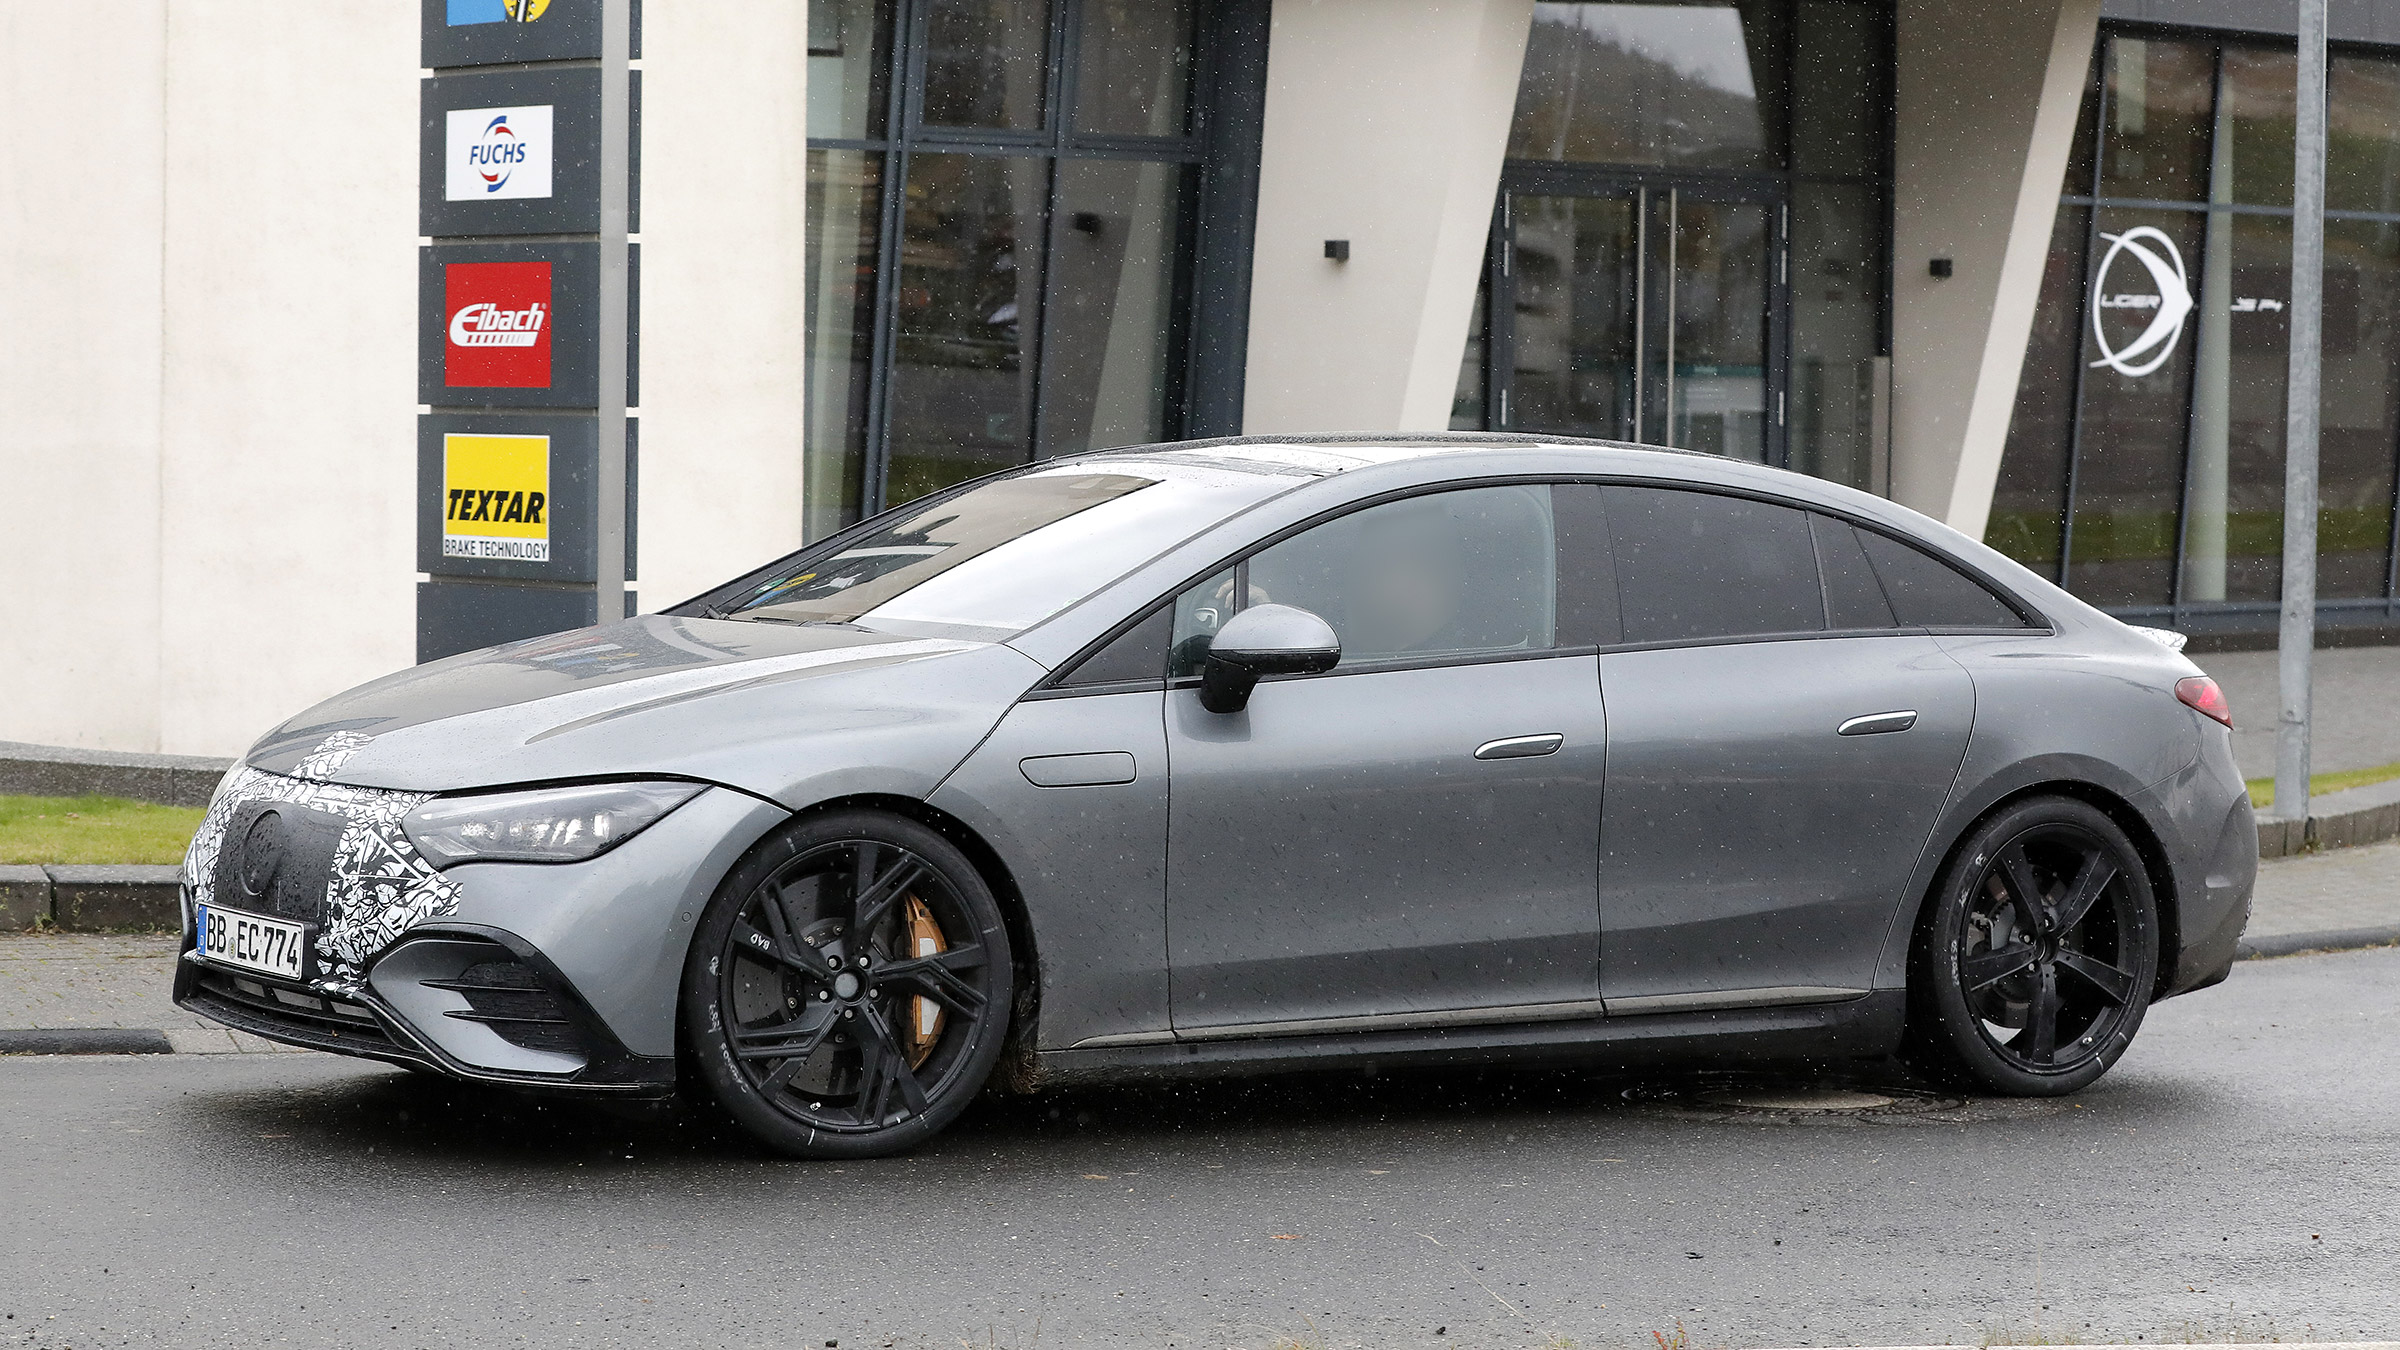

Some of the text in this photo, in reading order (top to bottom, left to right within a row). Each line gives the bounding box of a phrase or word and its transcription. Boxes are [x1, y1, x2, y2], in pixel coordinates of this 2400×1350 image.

[469, 142, 526, 165] FUCHS
[450, 302, 545, 347] Eibach
[447, 489, 545, 523] TEXTAR
[445, 539, 547, 559] BRAKE TECHNOLOGY
[206, 913, 227, 953] BB
